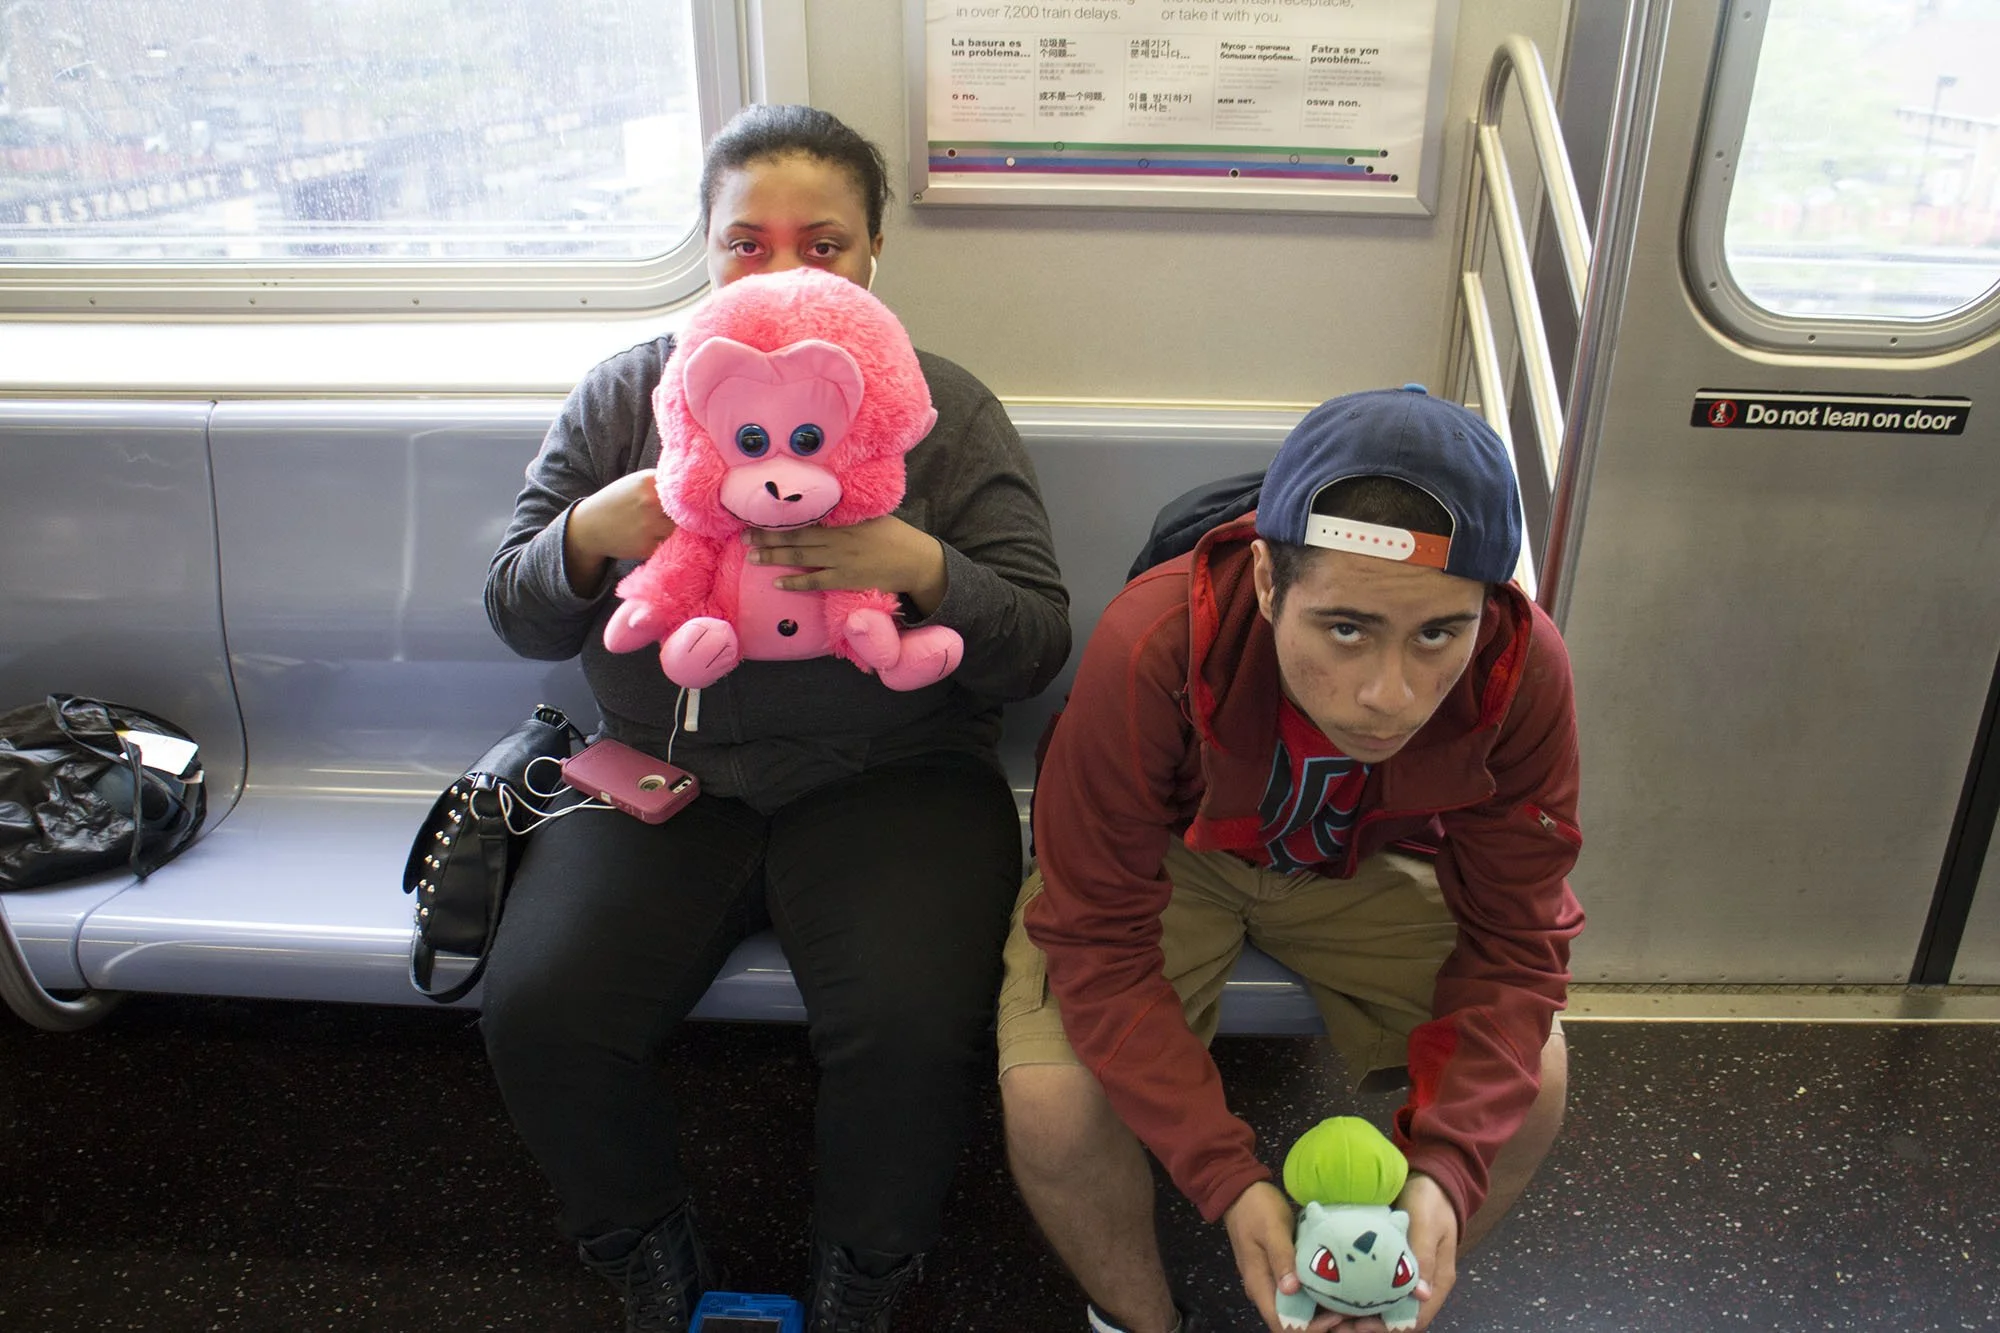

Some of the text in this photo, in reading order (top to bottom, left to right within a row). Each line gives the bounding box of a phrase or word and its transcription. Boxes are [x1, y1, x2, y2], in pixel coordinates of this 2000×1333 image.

[956, 4, 1121, 22] in over 7,200 train delays.
[1161, 8, 1281, 24] or take it with you.
[951, 38, 964, 46] La
[968, 38, 1005, 47] basura
[1220, 42, 1246, 51] Мусор
[969, 49, 1031, 58] problema...
[1311, 45, 1340, 54] Fatra
[1360, 48, 1379, 56] yon
[1306, 99, 1361, 108] oswa non.
[1745, 404, 1957, 430] Do not lean on door
